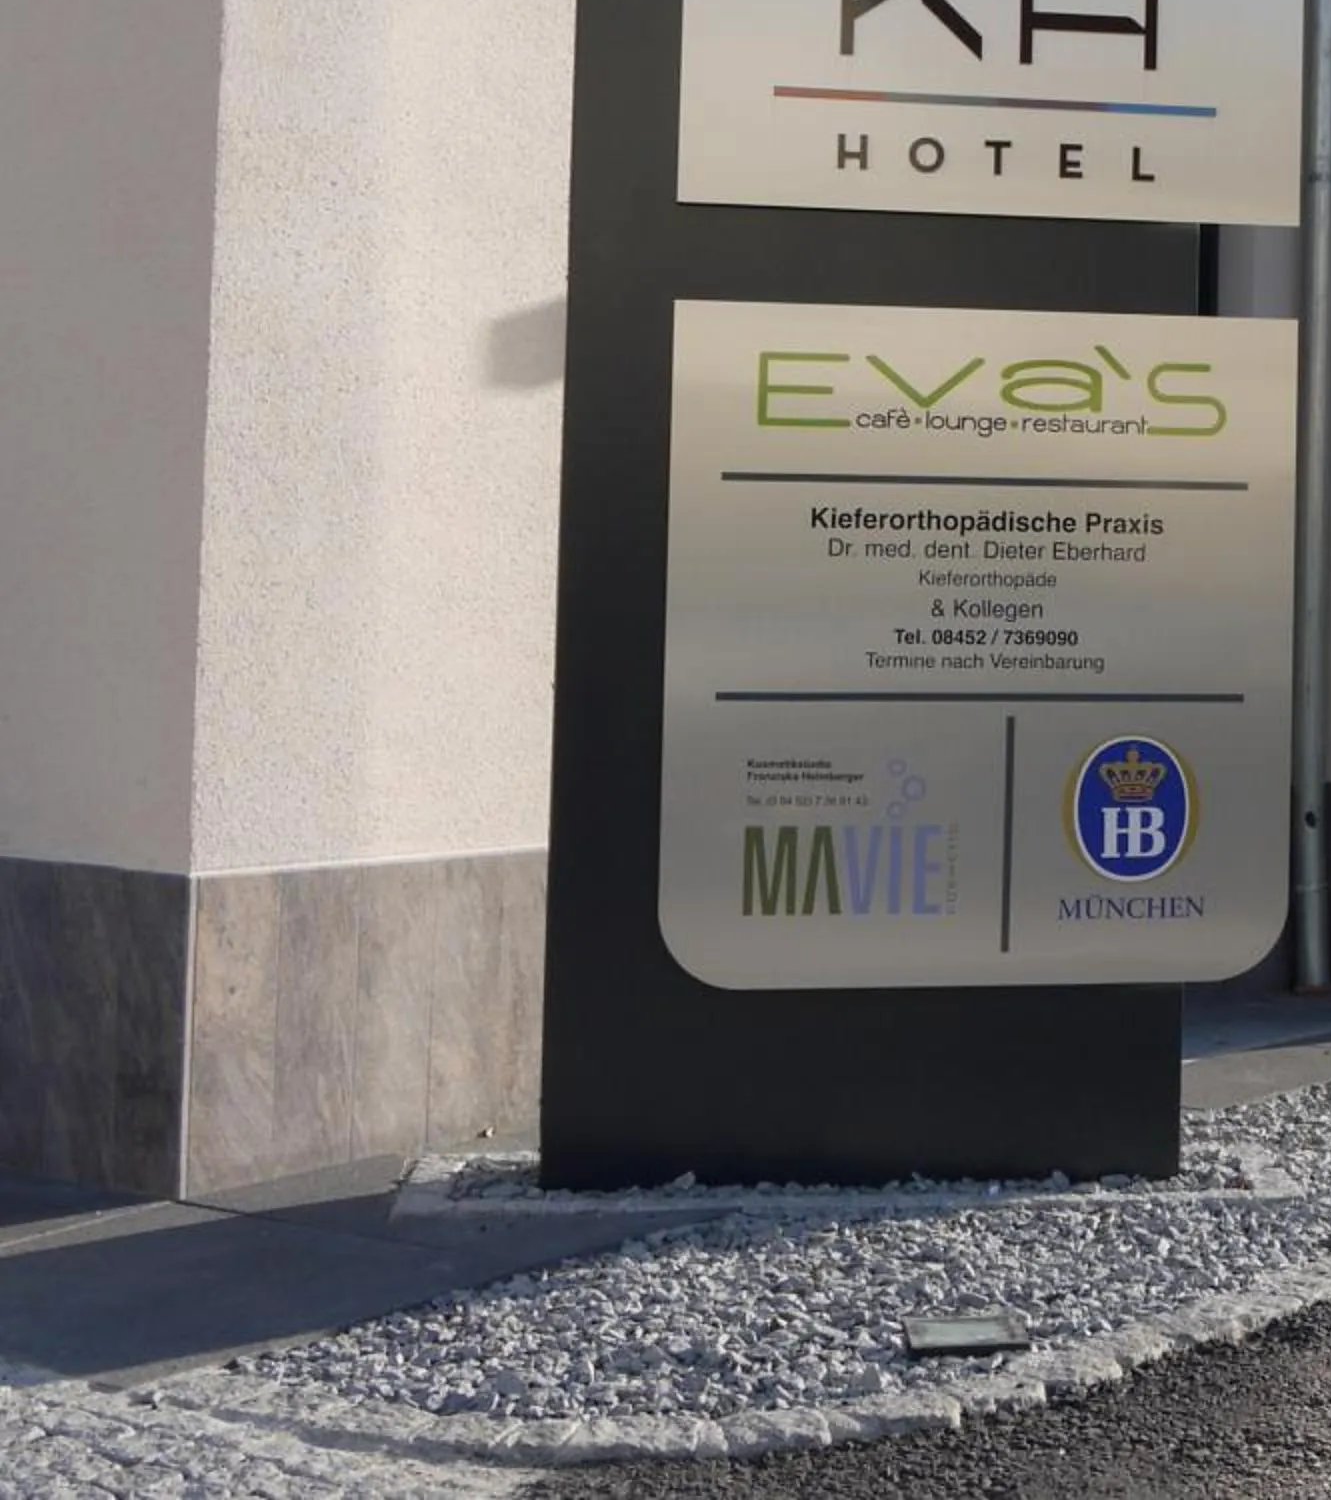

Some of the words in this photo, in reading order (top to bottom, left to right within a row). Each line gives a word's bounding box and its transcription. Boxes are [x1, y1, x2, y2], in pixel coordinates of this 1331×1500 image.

[836, 133, 1156, 182] HOTEL
[924, 411, 1007, 438] lounge
[1021, 414, 1148, 436] restaurant
[810, 506, 1077, 536] Kieferorthopädische
[1085, 512, 1164, 535] Praxis
[827, 537, 857, 557] Dr.
[864, 539, 917, 559] med.
[983, 540, 1046, 560] Dieter
[1052, 541, 1147, 563] Eberhard
[918, 568, 1057, 590] Kieferorthopäde
[930, 599, 945, 618] &
[952, 599, 1044, 623] Kollegen
[893, 628, 926, 646] Tel.
[931, 628, 986, 647] 08452
[1003, 630, 1079, 647] 7369090
[865, 651, 936, 670] Termine
[941, 652, 985, 670] nach
[989, 653, 1106, 675] Vereinbarung
[1100, 805, 1166, 860] HB
[1057, 893, 1205, 921] MÜNCHEN
